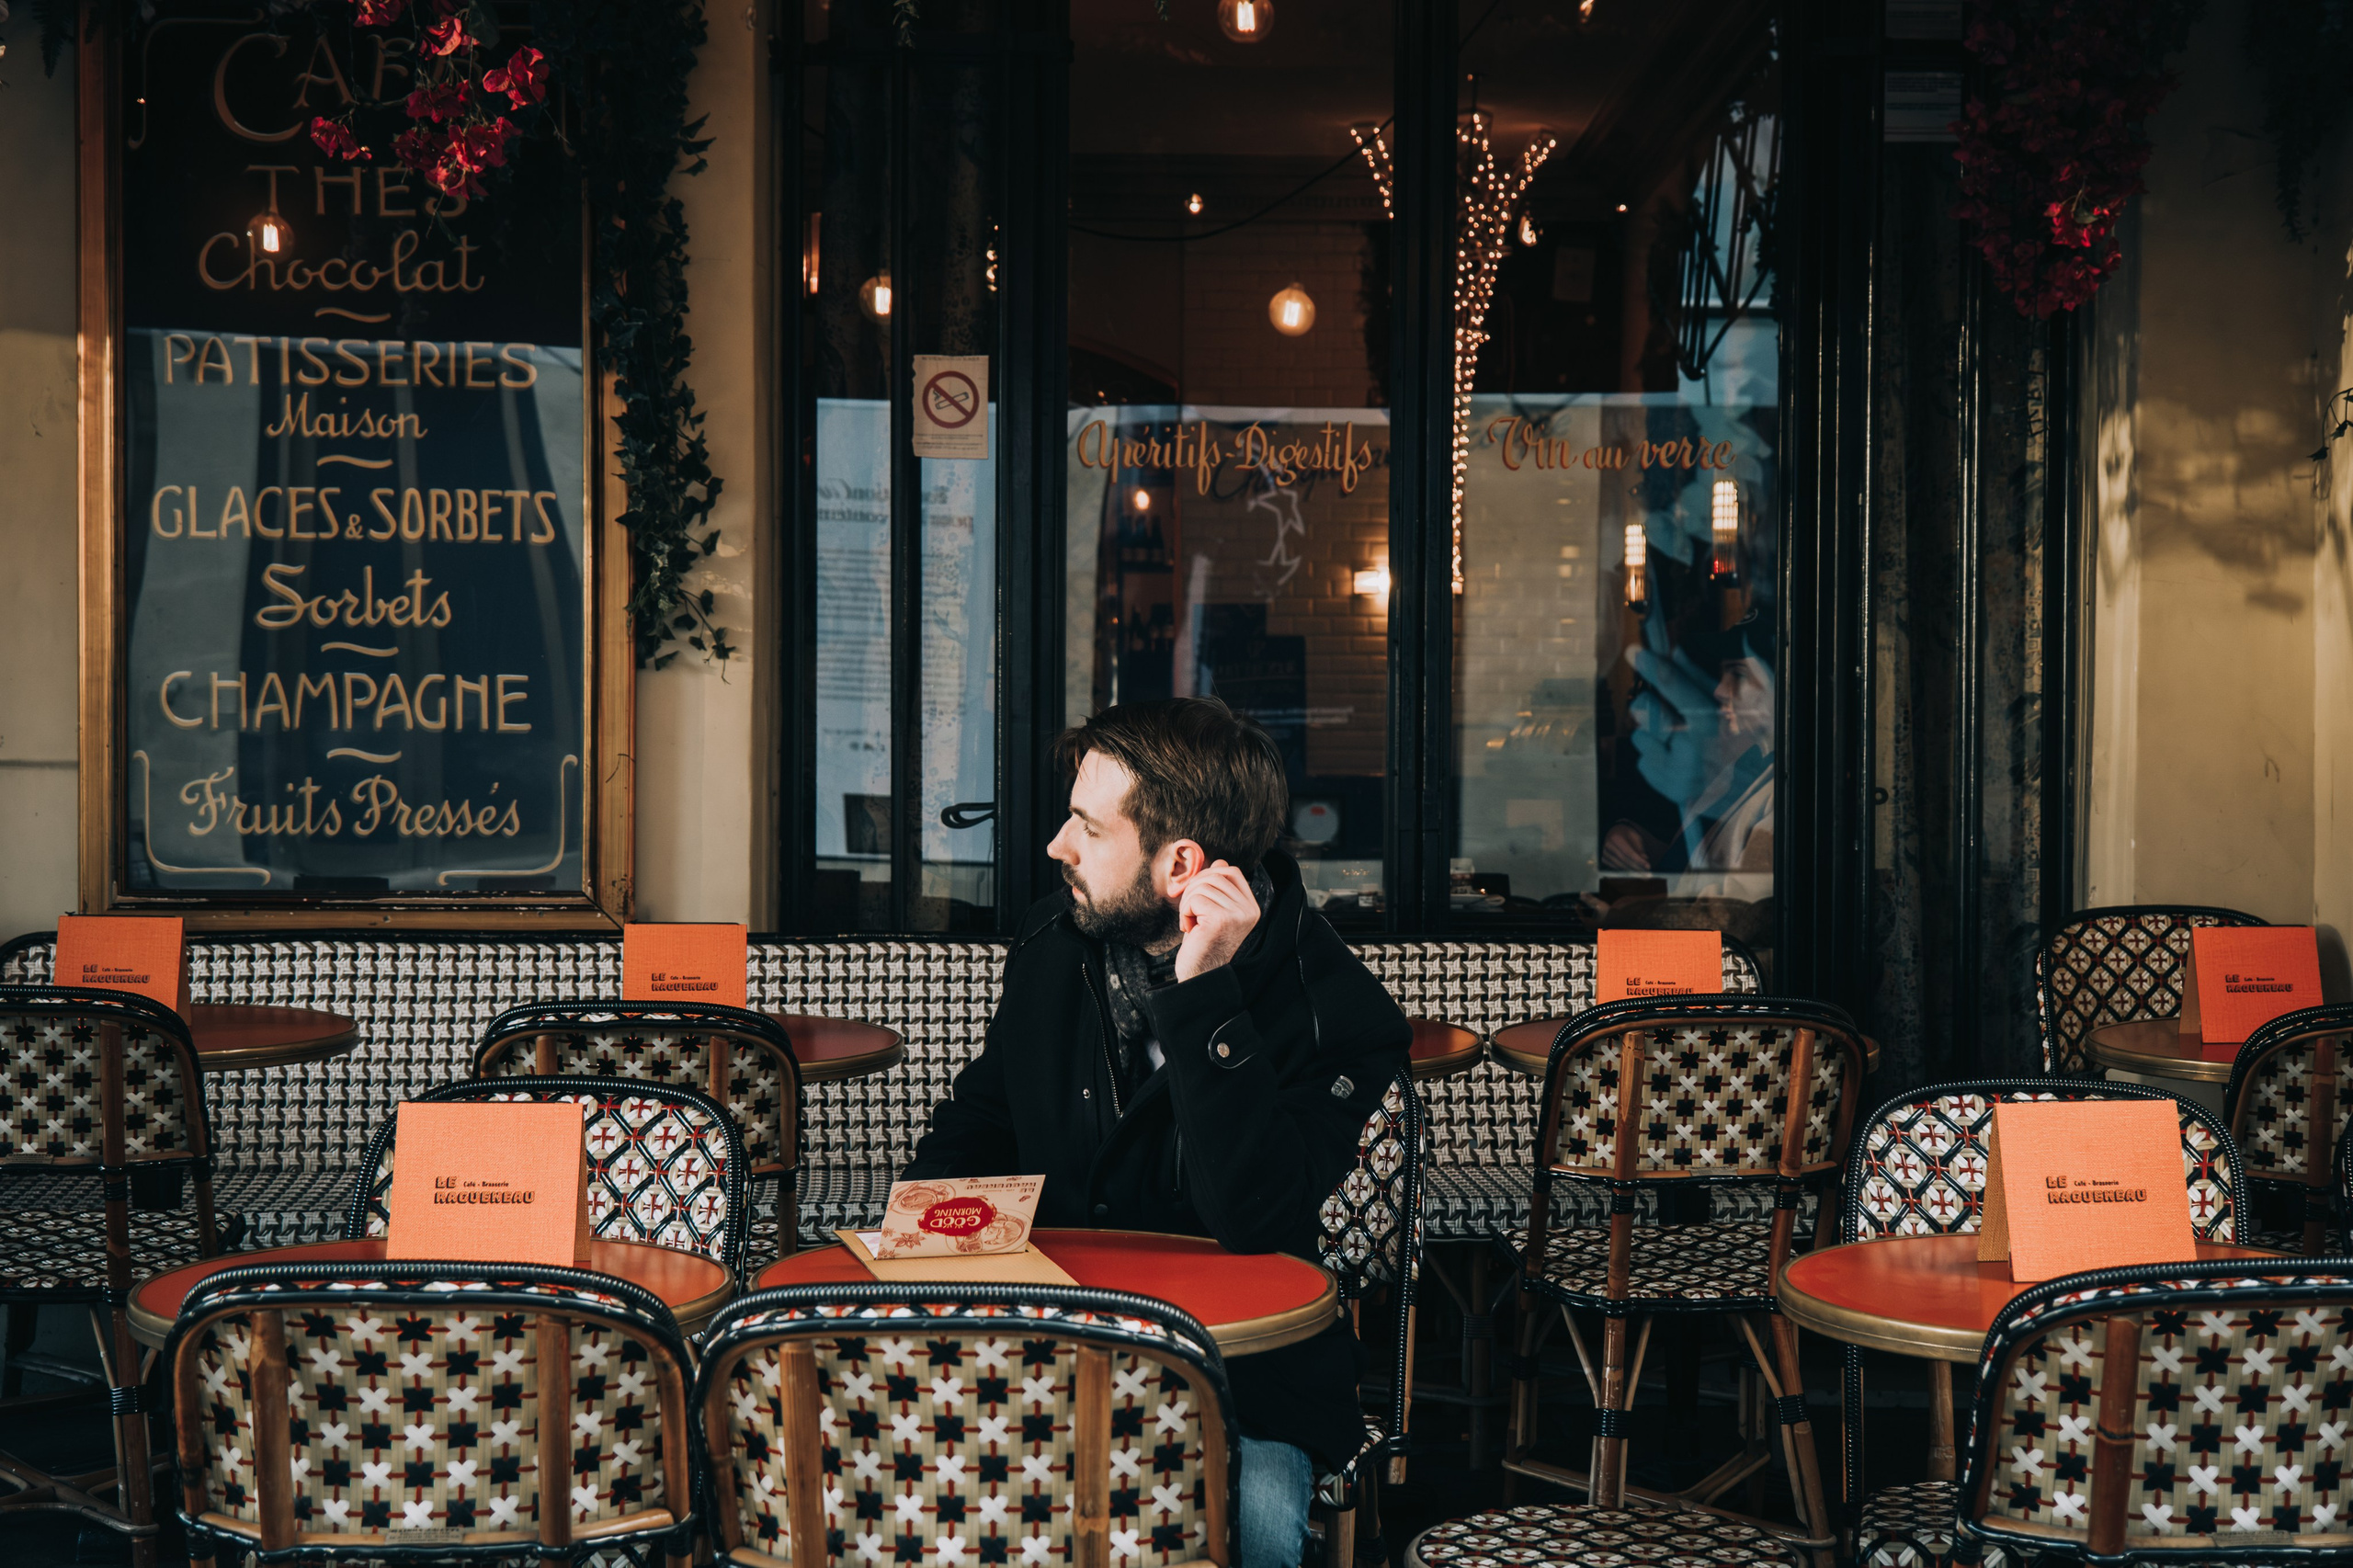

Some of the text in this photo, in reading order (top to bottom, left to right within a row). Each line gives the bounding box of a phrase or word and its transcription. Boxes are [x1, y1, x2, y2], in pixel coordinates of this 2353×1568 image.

[199, 230, 484, 292] Chocolat
[164, 334, 538, 388] PATISSERIES
[266, 392, 428, 439] Maison
[1488, 416, 1736, 471] Vin au verre
[152, 485, 556, 544] GLACES & SORBETS
[255, 563, 452, 629] Sorbets
[160, 671, 532, 731] CHAMPAGNE
[180, 767, 521, 837] Fruits Pressés
[435, 1176, 457, 1188] LE
[2045, 1176, 2067, 1188] LE
[930, 1214, 981, 1229] GOOD
[934, 1206, 983, 1218] MORNING
